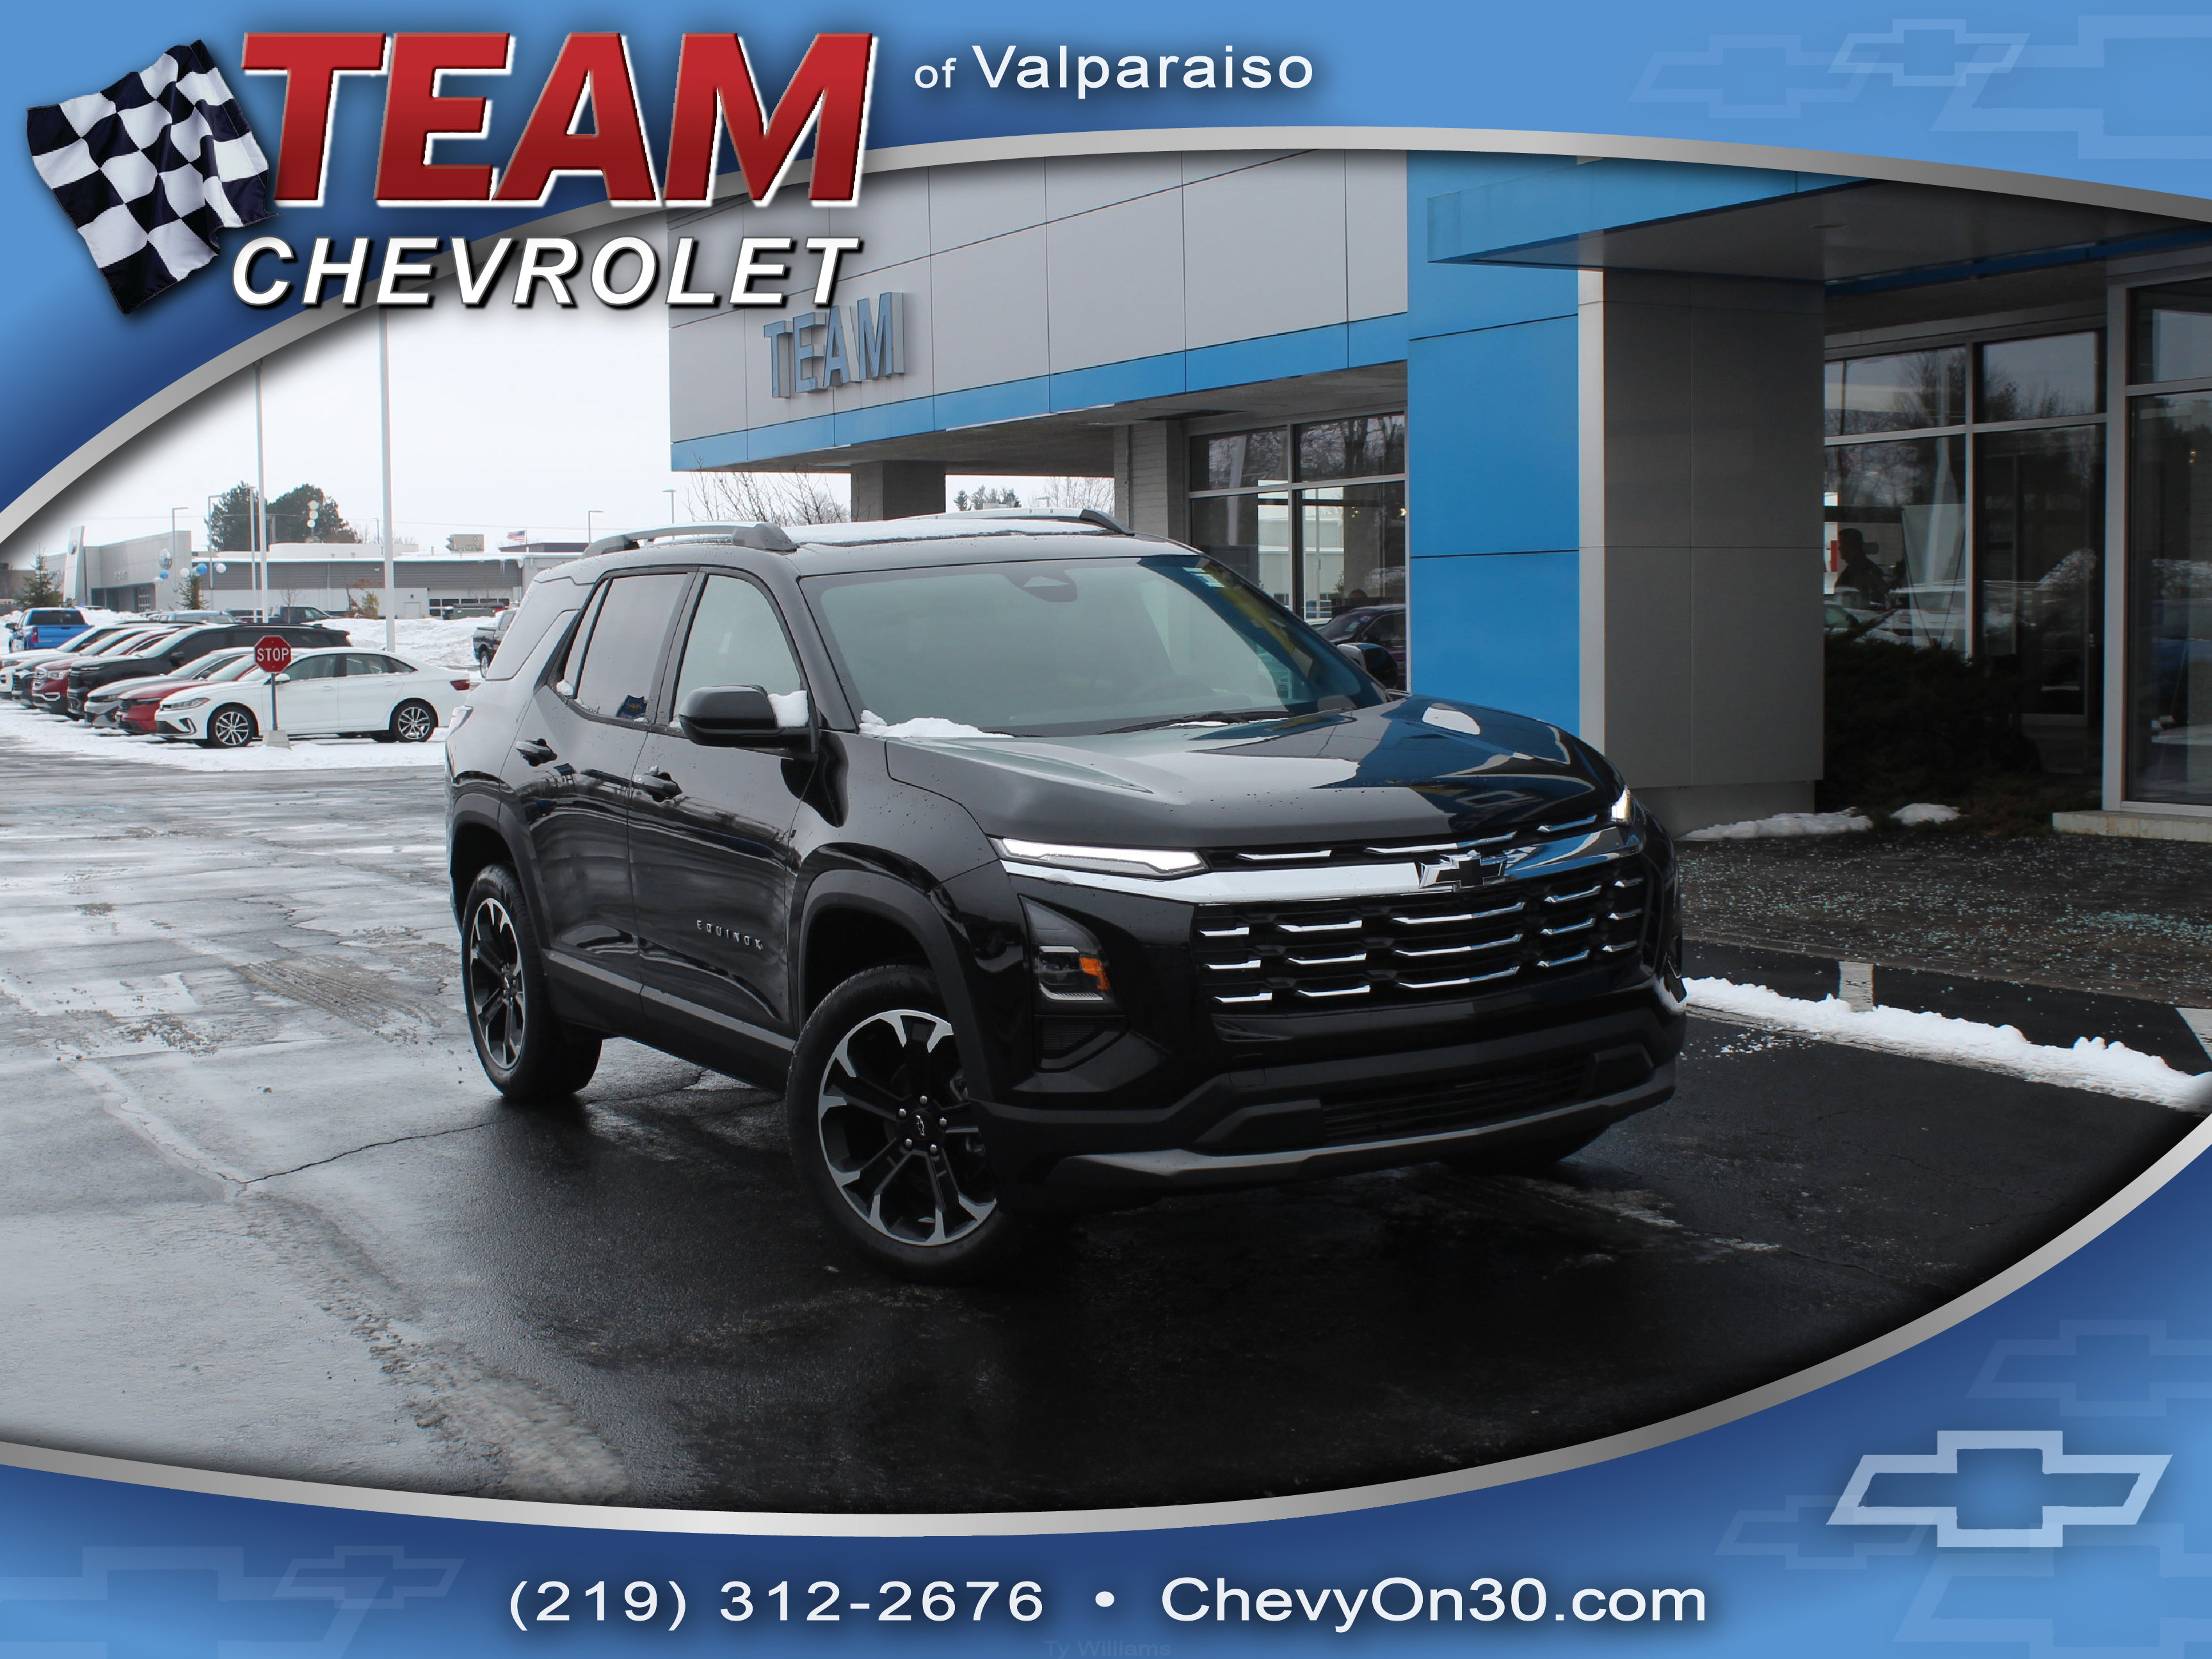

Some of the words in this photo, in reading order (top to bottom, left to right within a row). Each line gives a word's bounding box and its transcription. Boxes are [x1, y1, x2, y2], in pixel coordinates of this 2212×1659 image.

[764, 292, 904, 398] TEAM
[257, 647, 290, 662] STOP
[696, 920, 764, 950] EQUINOX
